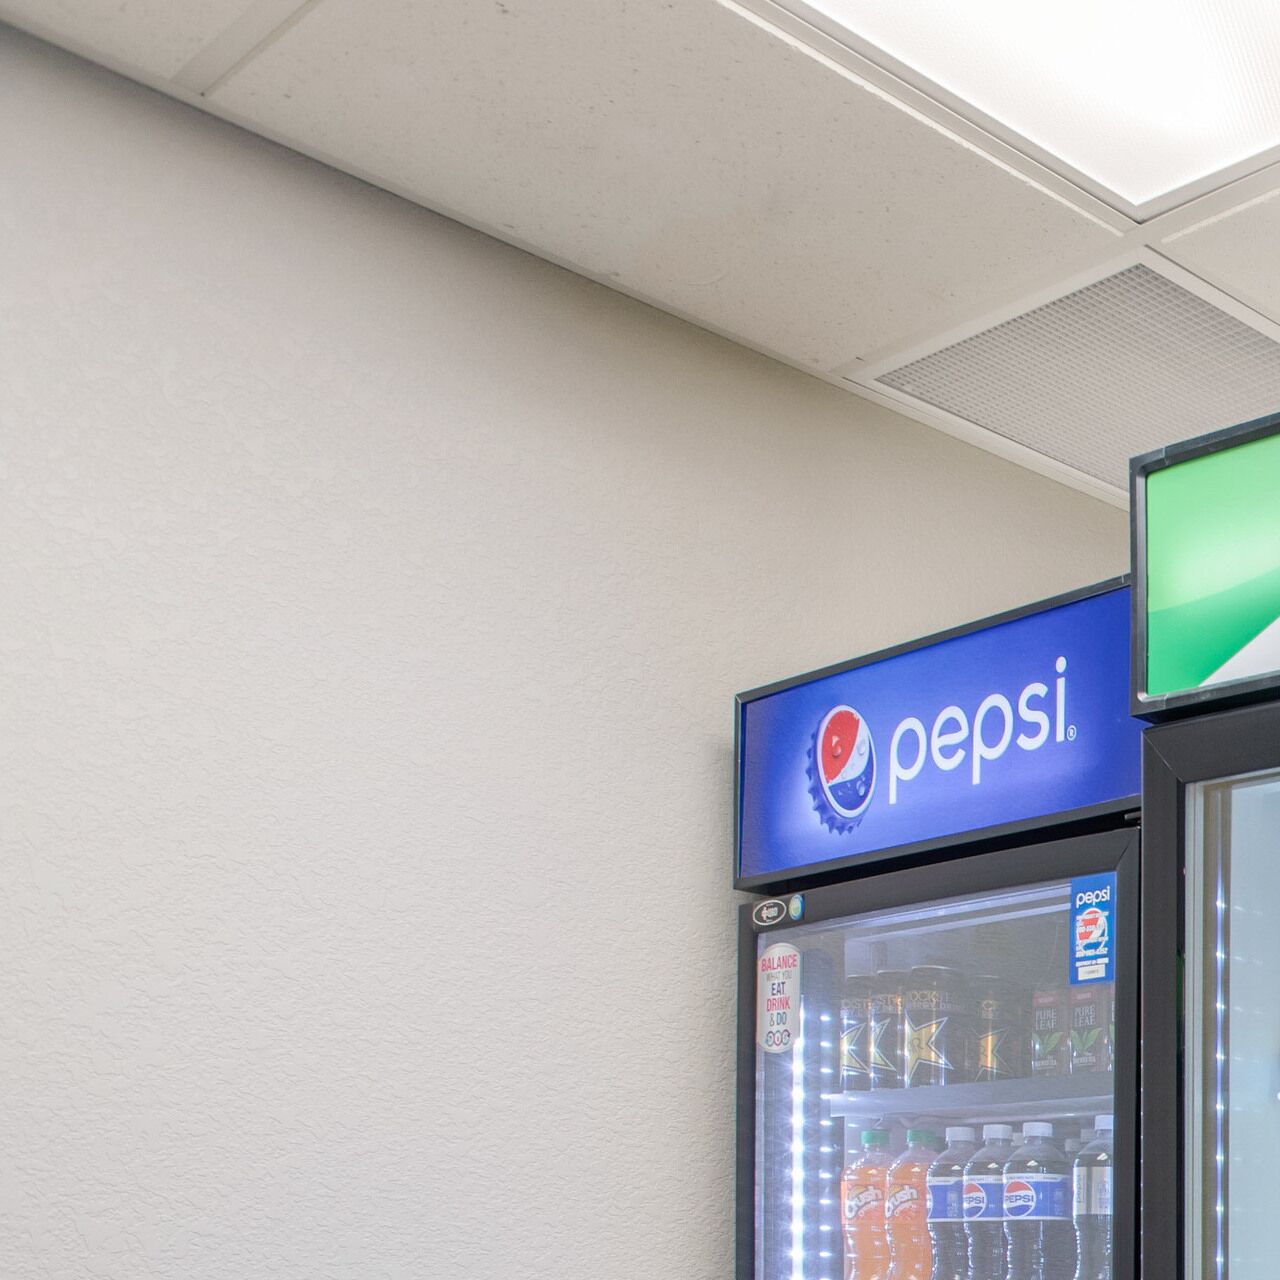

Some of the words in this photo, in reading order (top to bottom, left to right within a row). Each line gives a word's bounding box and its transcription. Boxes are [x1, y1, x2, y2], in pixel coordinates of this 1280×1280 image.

[889, 656, 1067, 805] pepsi
[1076, 886, 1110, 908] pepsi
[761, 954, 797, 972] BALANCE
[771, 982, 785, 995] EAT
[767, 997, 790, 1011] DRINK
[776, 1012, 787, 1025] DO
